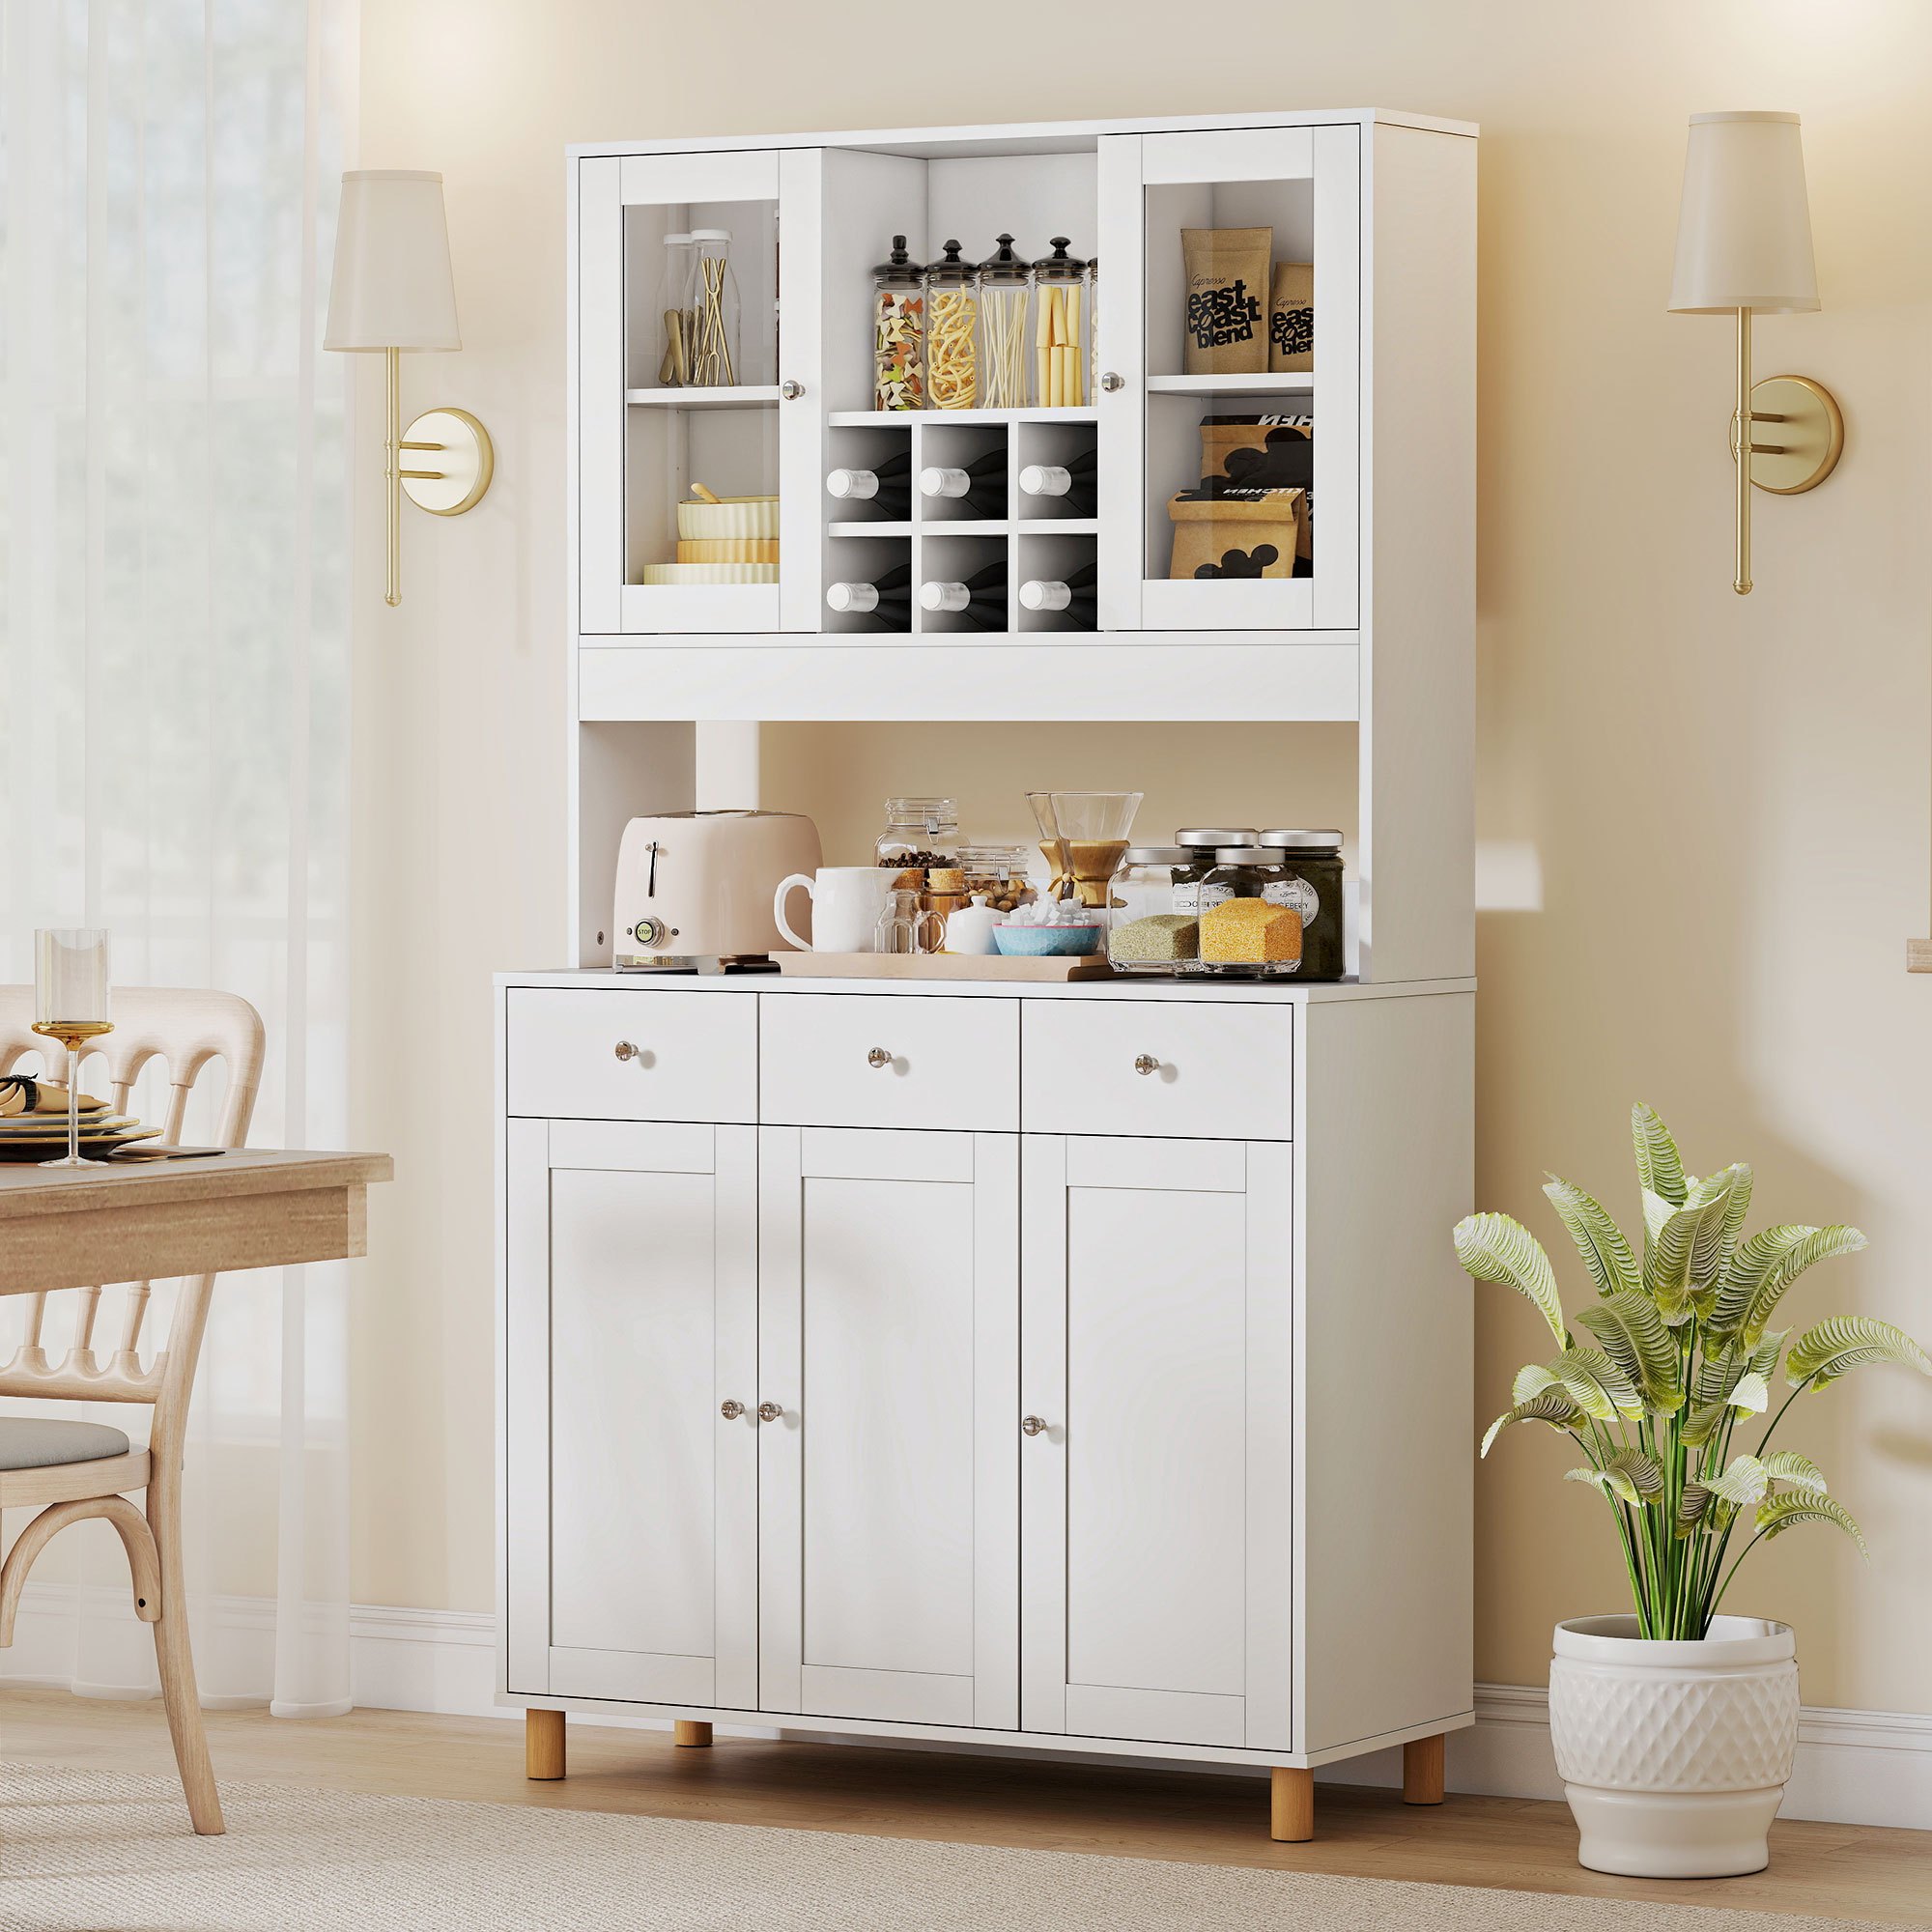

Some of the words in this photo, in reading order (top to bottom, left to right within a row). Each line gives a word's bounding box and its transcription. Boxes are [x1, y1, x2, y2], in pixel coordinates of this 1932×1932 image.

[1188, 279, 1247, 312] east
[1188, 296, 1262, 334] coast
[1272, 307, 1314, 328] eas
[1197, 319, 1253, 349] blend
[1270, 323, 1314, 344] coa
